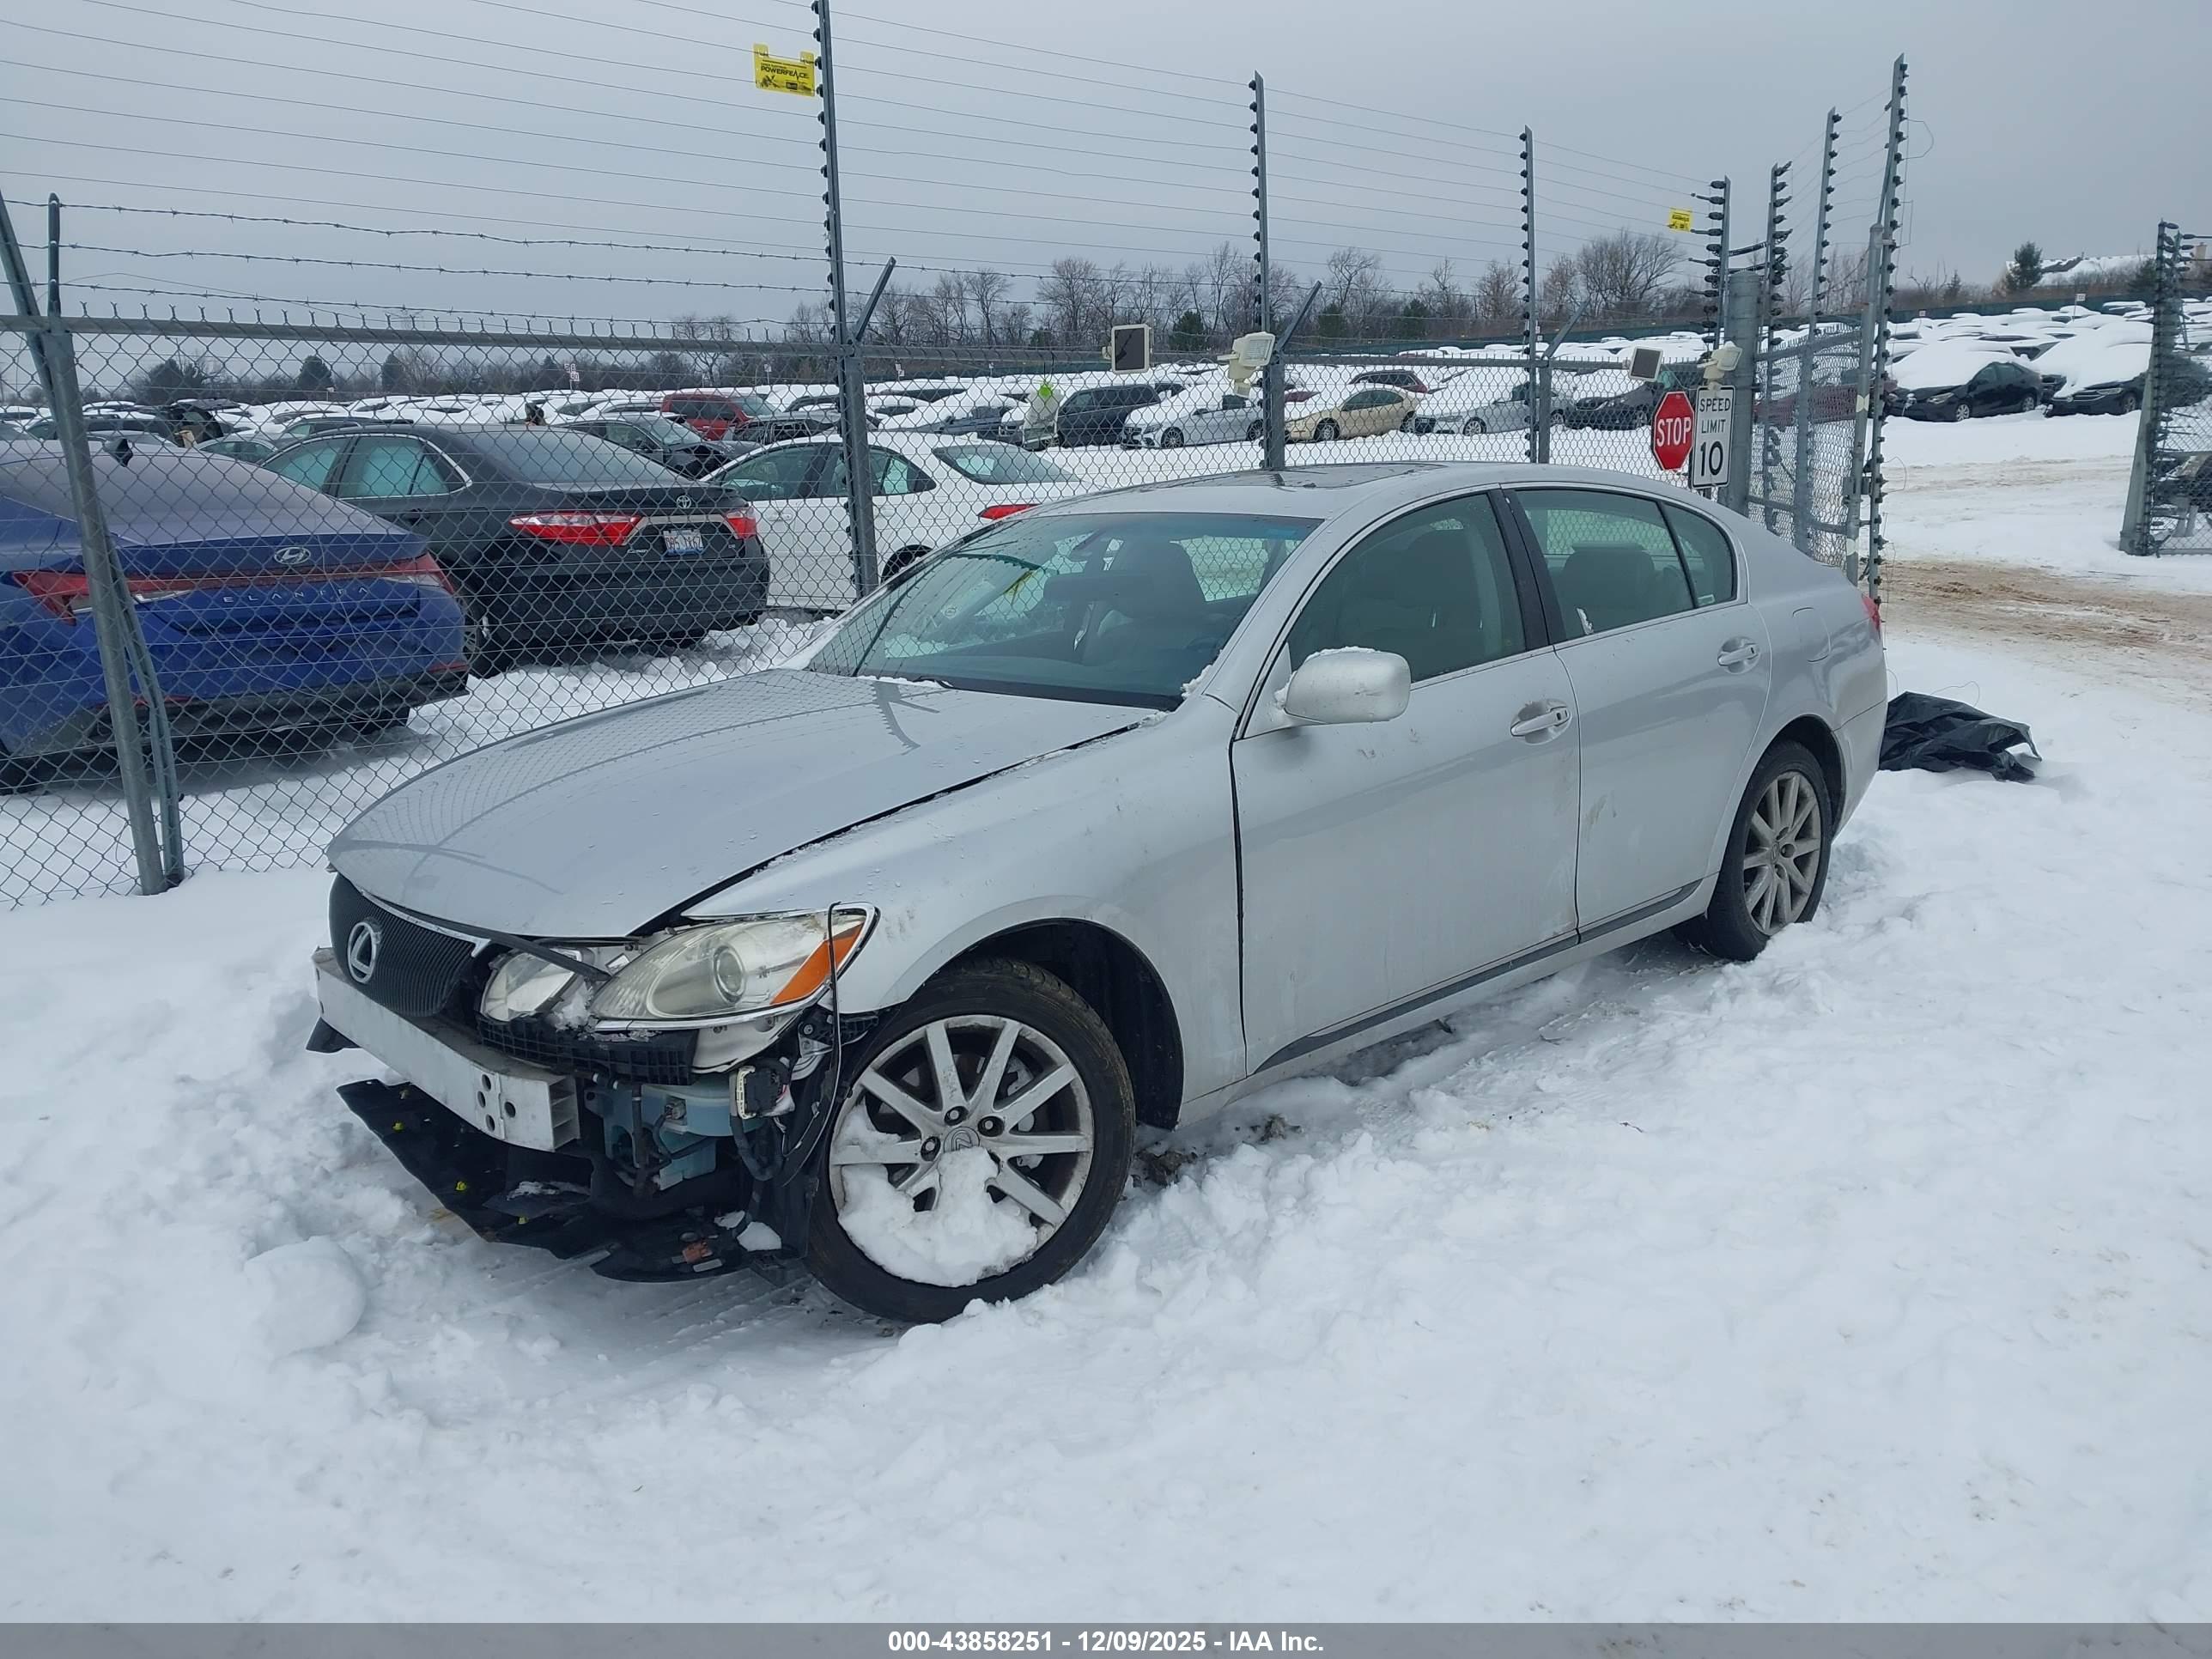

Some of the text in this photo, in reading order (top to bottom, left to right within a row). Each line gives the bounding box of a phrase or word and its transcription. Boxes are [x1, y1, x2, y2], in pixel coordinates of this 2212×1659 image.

[1699, 398, 1731, 412] SPEED
[1656, 416, 1692, 447] STOP
[1701, 419, 1726, 434] LIMIT
[1700, 441, 1723, 477] 10
